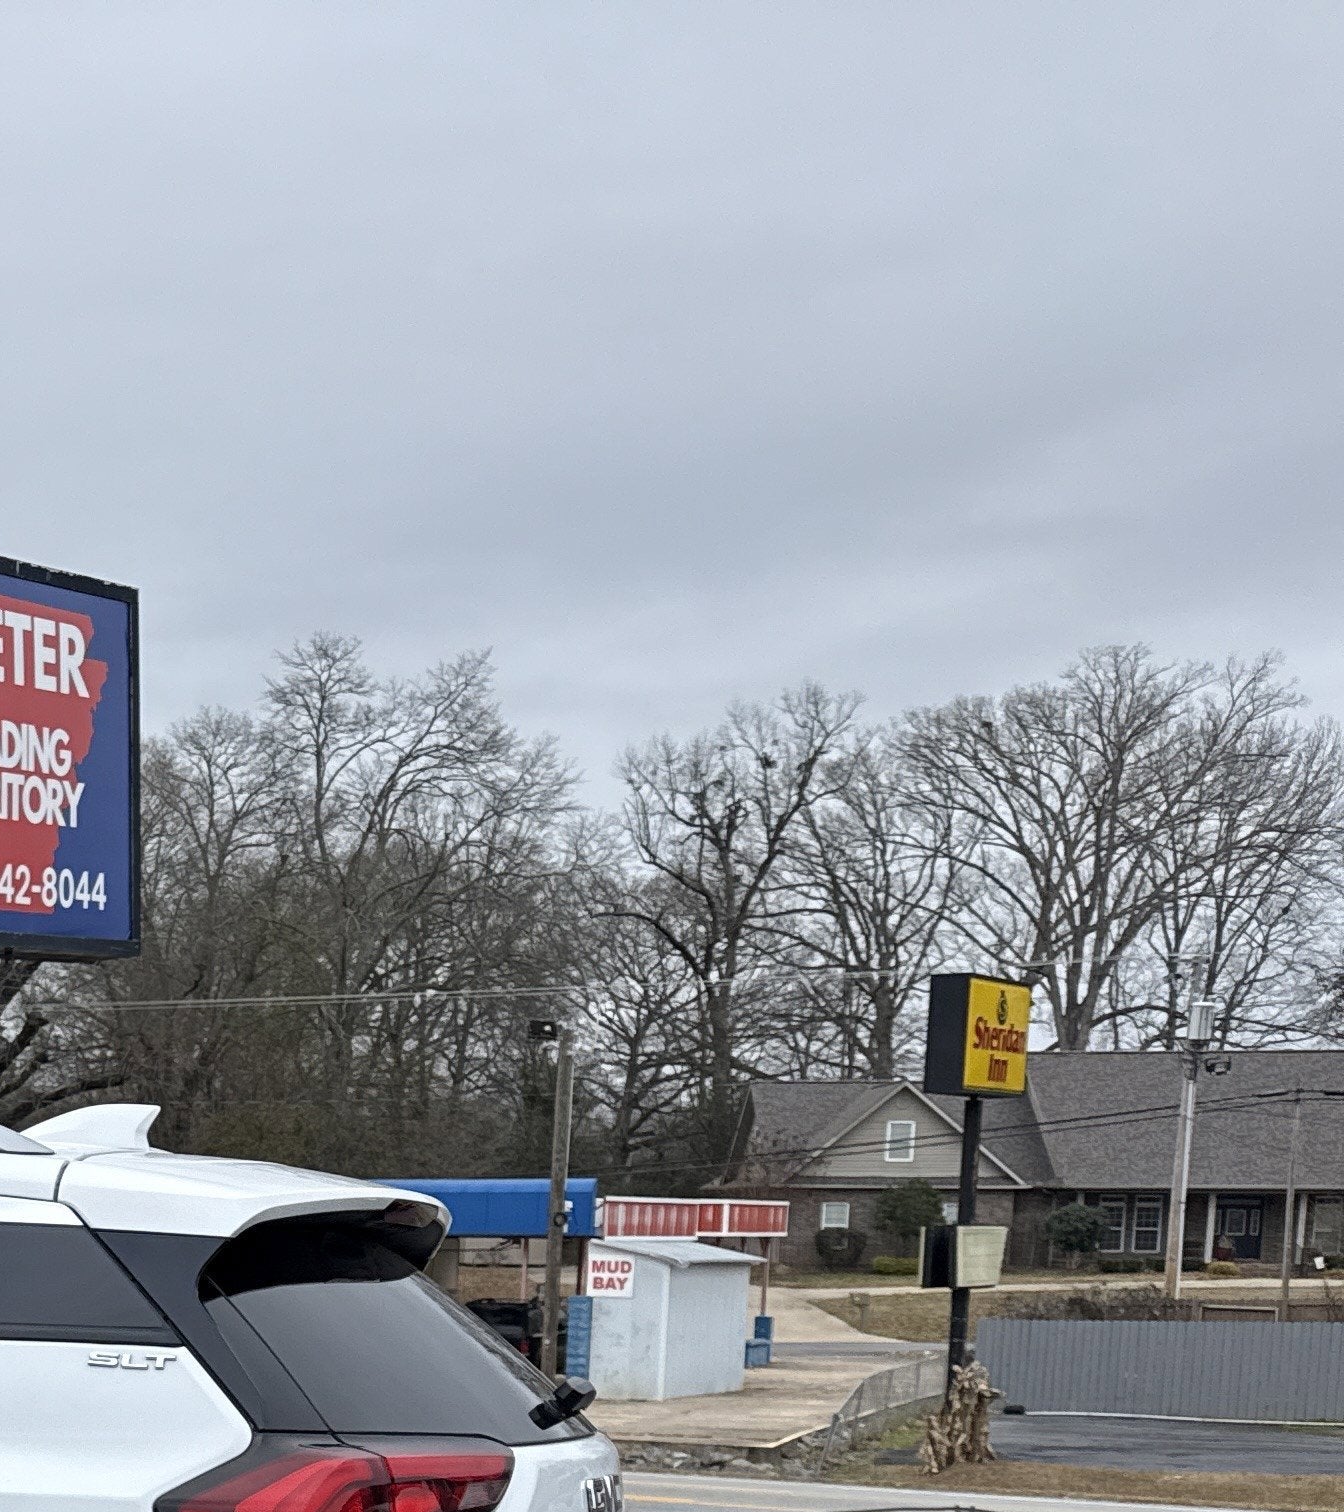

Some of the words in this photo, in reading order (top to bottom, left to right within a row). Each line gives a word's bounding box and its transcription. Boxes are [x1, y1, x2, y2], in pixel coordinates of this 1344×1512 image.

[973, 1016, 1026, 1054] Sheridan
[987, 1053, 1009, 1082] Inn
[592, 1260, 632, 1273] MUD
[593, 1276, 628, 1290] BAY
[87, 1351, 177, 1370] SLT
